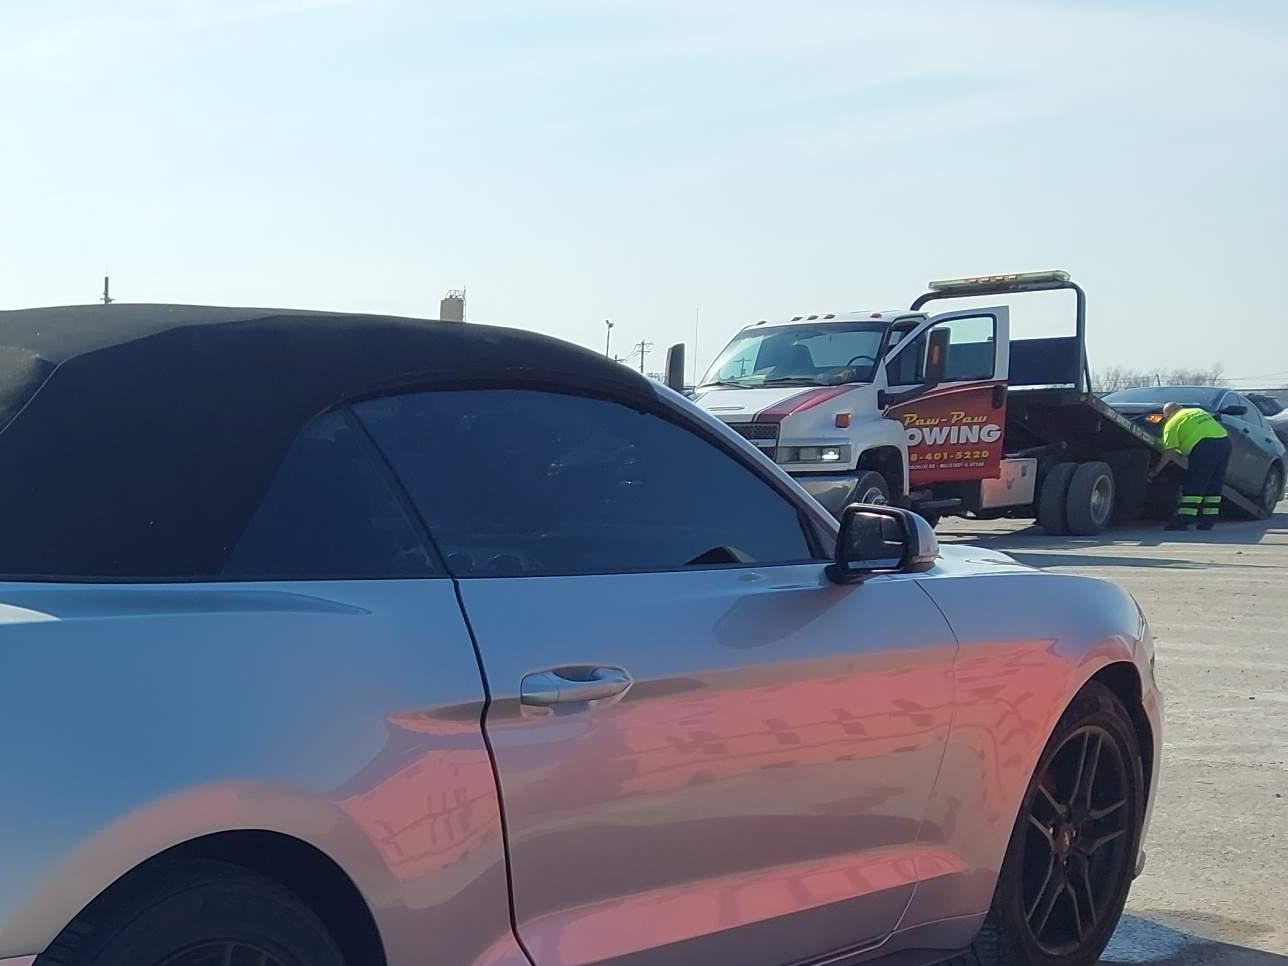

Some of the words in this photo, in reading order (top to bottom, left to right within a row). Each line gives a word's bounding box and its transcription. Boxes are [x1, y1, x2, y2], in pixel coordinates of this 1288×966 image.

[903, 411, 987, 426] Paw-Paw
[904, 424, 1001, 447] OWING
[910, 450, 989, 461] 8-401-5220
